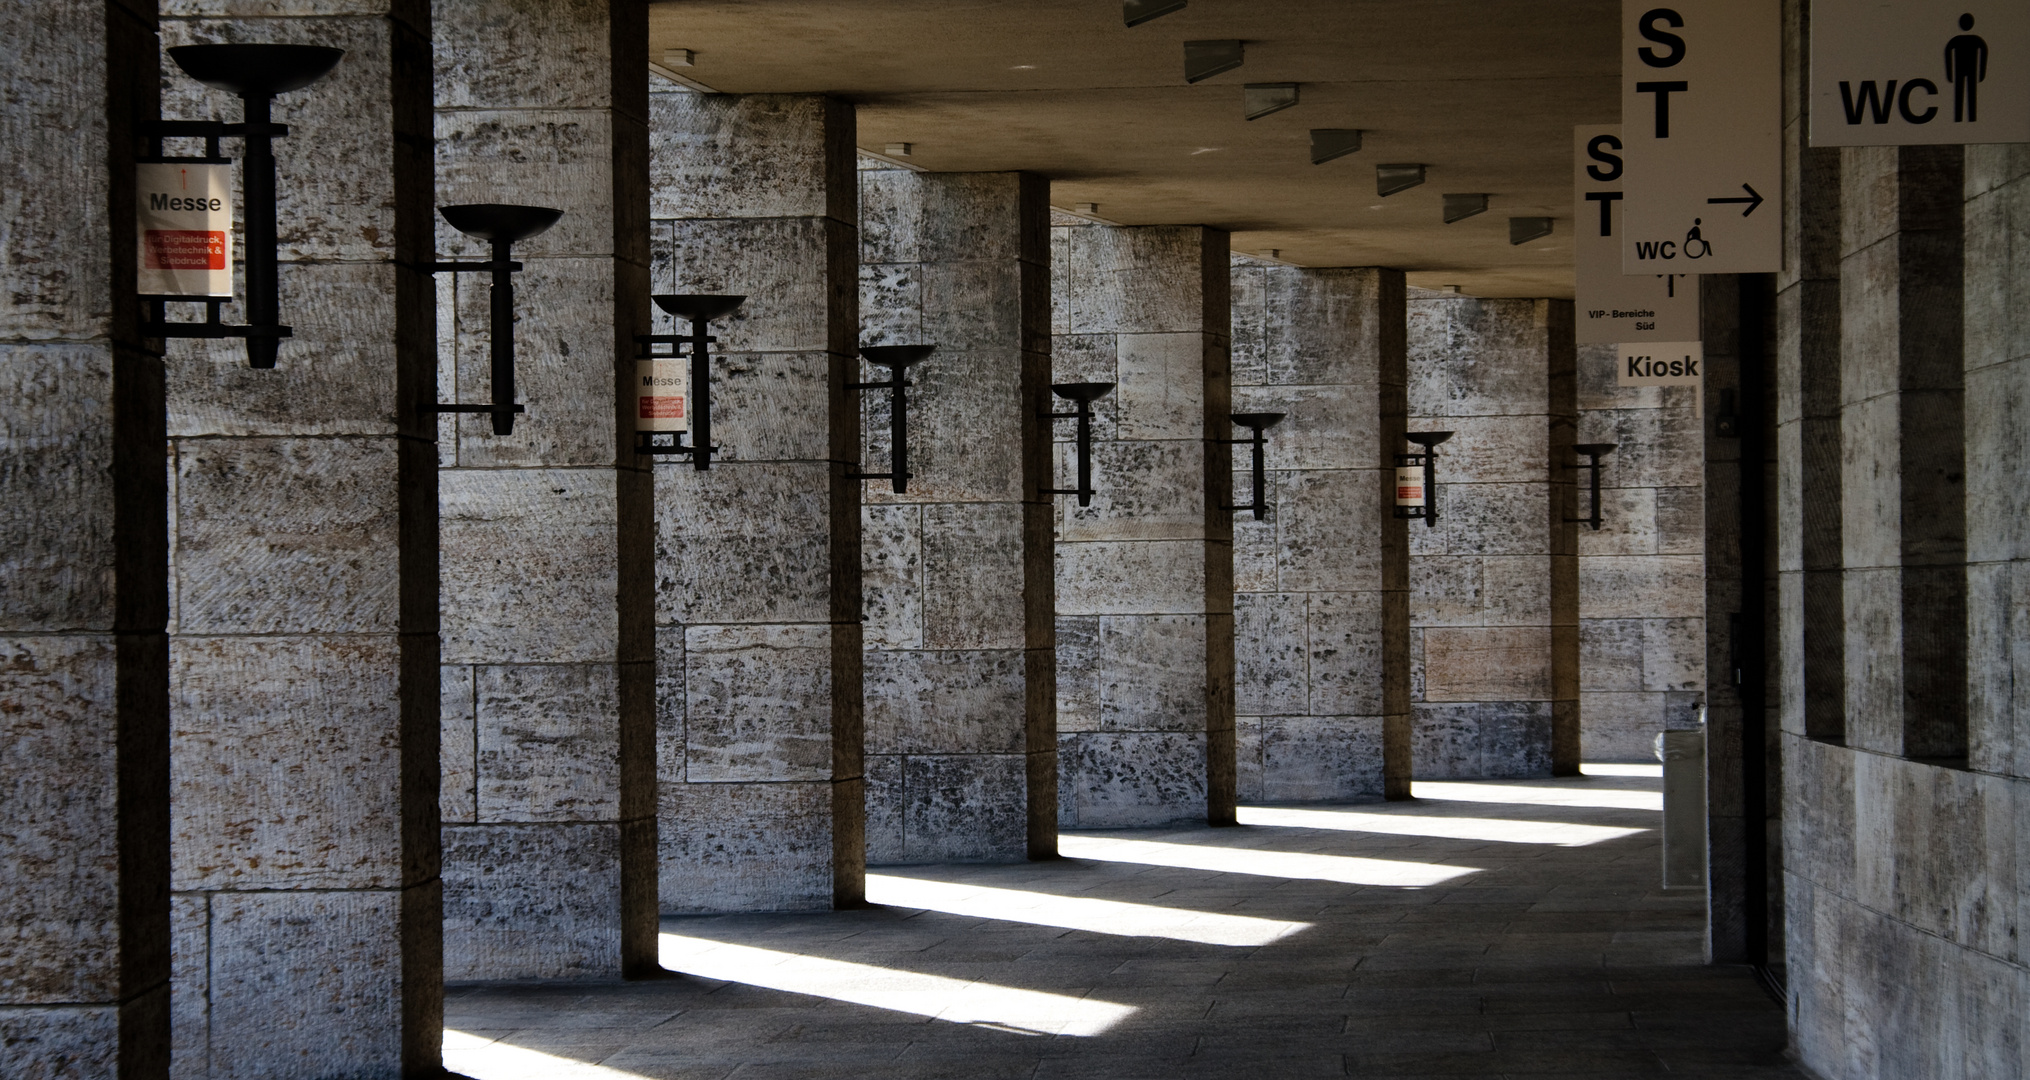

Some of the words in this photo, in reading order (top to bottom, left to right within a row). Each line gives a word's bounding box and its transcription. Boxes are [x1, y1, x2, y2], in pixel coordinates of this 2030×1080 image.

[1839, 77, 1940, 126] WC
[150, 193, 222, 211] Messe
[164, 235, 223, 246] Digitaldruck,
[149, 246, 213, 254] Werbetechnik
[214, 246, 222, 254] &
[1636, 241, 1676, 260] WC
[160, 256, 207, 264] Siebdruck
[1636, 322, 1655, 331] Süd
[1628, 355, 1699, 377] Kiosk
[643, 376, 681, 386] Messe
